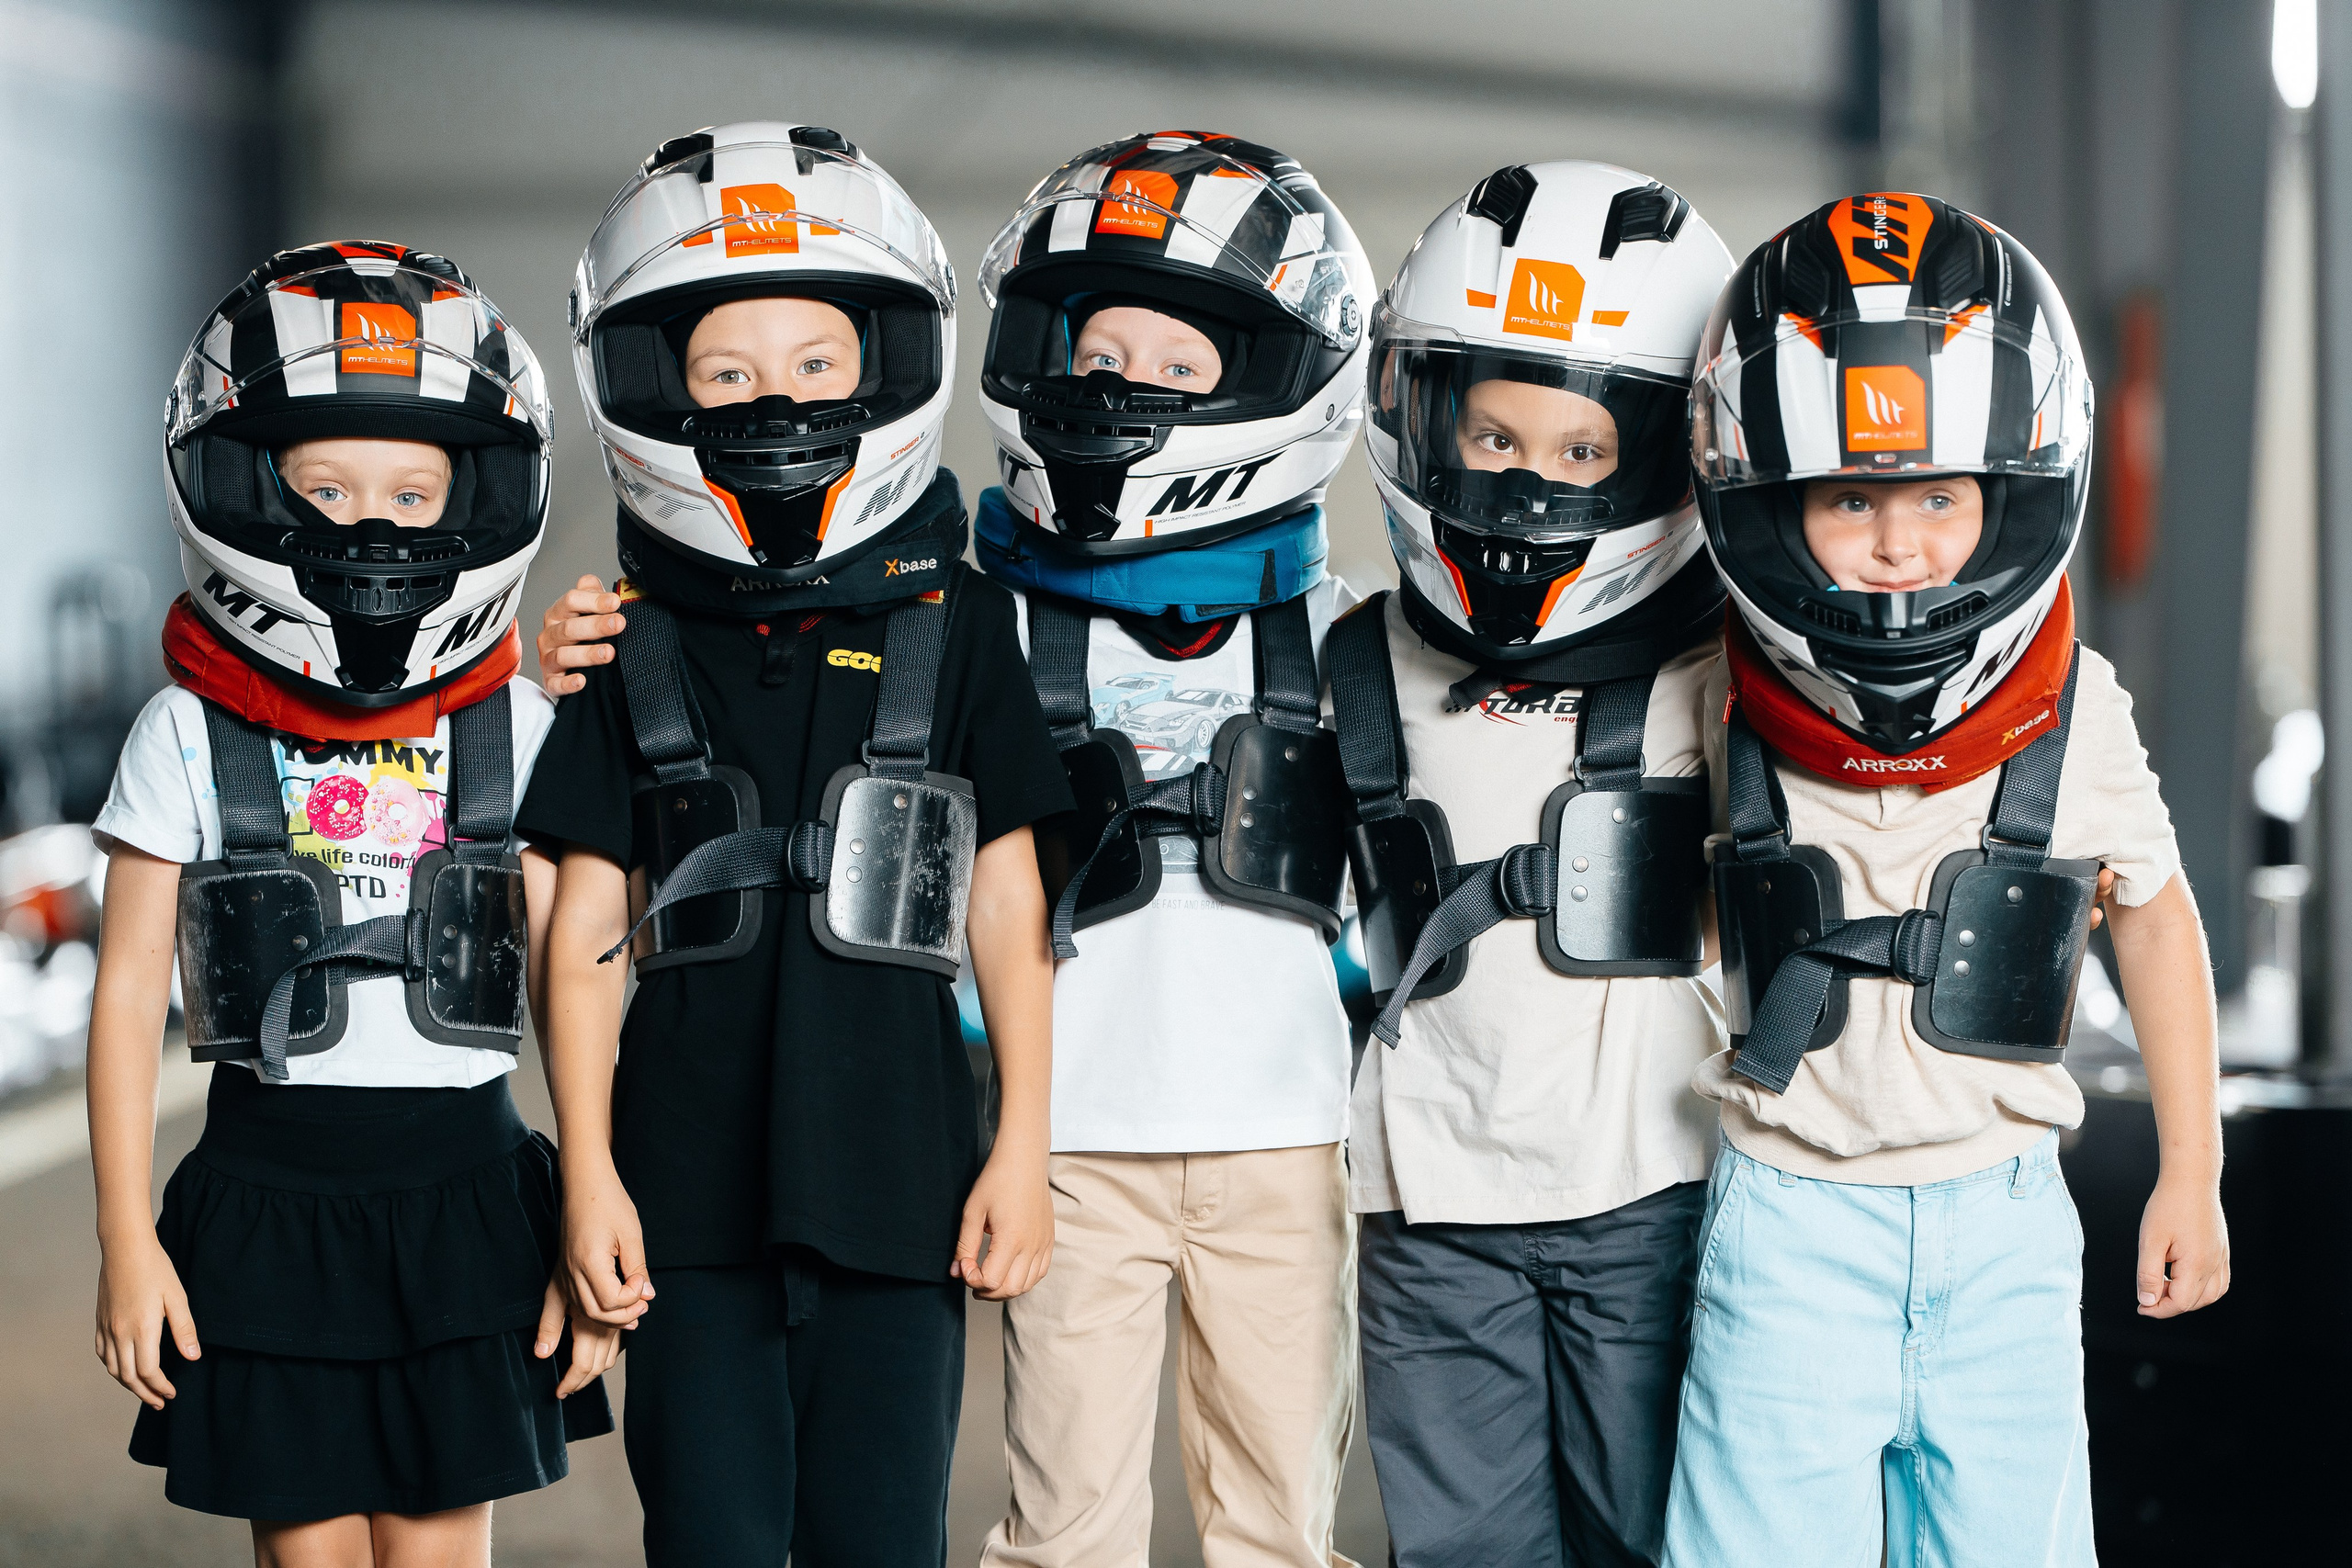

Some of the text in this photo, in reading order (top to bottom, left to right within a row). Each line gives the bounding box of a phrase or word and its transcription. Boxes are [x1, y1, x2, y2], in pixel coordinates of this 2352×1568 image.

[1874, 198, 1889, 250] STINGER
[890, 435, 920, 460] STINGER
[853, 434, 939, 526] MT
[1145, 448, 1288, 517] MT
[1192, 507, 1222, 518] RESISTANT
[1221, 501, 1247, 511] POLYMER
[1626, 536, 1666, 559] STINGER
[884, 558, 937, 578] Xbase
[201, 571, 310, 635] MT
[432, 571, 523, 660] MT
[2001, 709, 2050, 746] Xbase
[1841, 754, 1948, 773] ARROXX
[321, 848, 353, 864] life
[1151, 899, 1226, 911] BE FAST AND BRAVE
